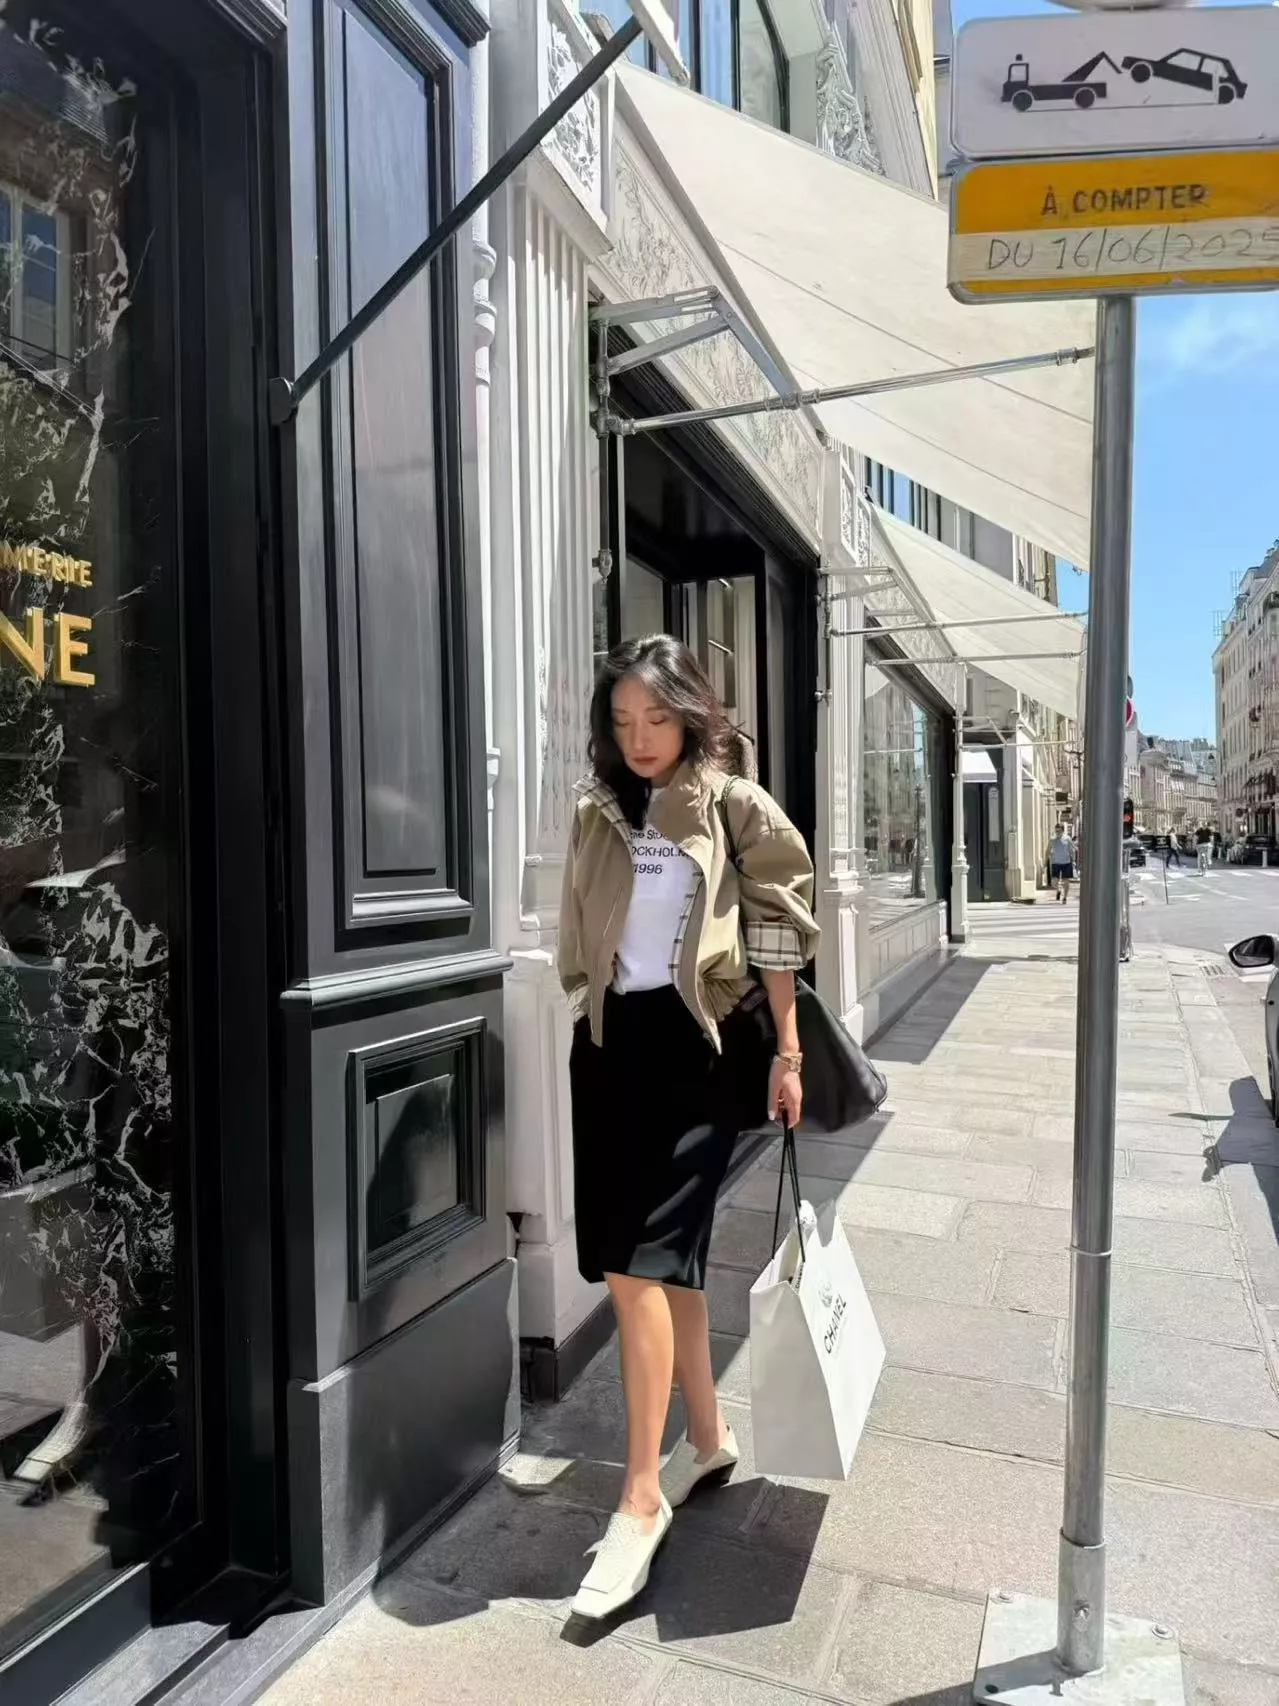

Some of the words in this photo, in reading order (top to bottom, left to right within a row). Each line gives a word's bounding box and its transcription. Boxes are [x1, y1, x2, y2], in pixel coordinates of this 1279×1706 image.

[1041, 185, 1058, 216] À
[1073, 184, 1208, 214] COMPTER
[988, 237, 1034, 271] DU
[633, 863, 664, 875] 1996
